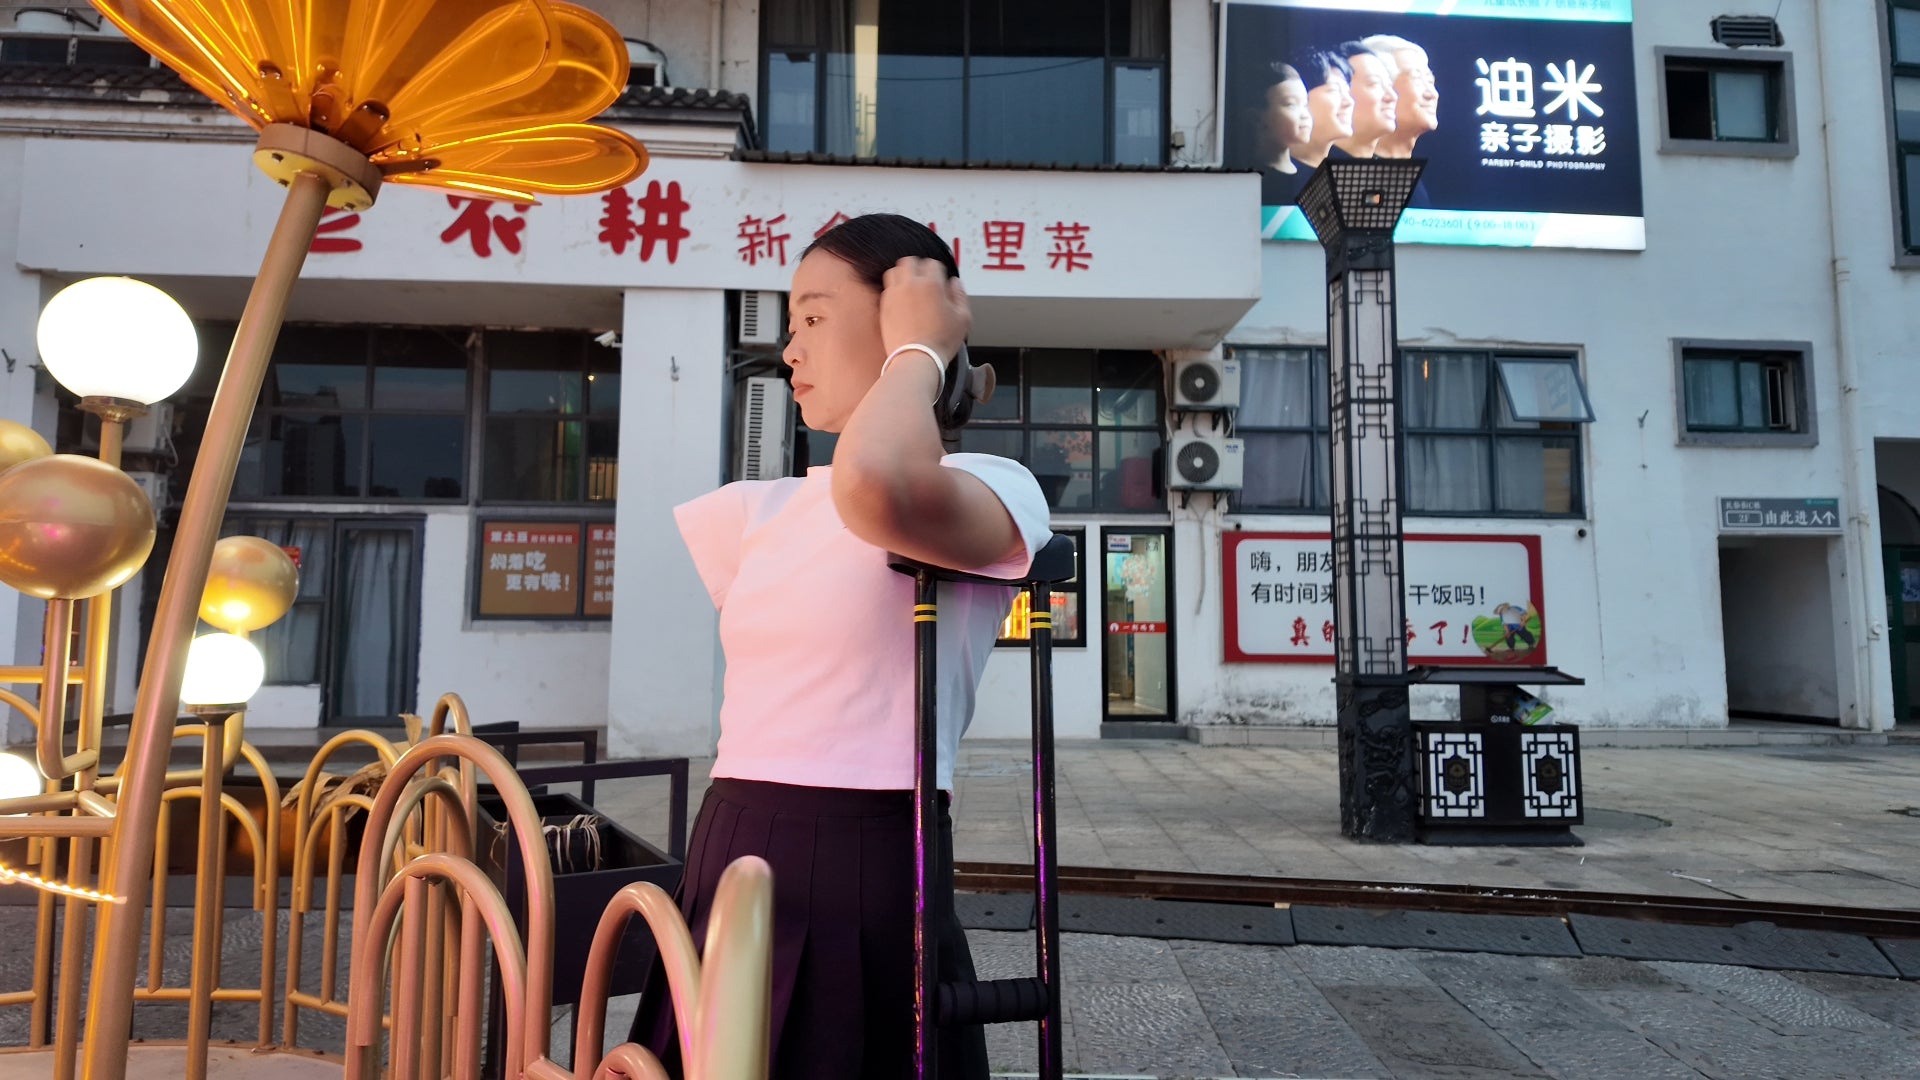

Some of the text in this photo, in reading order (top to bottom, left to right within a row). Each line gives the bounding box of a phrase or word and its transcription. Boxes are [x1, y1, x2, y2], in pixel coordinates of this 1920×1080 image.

[1474, 57, 1604, 121] 迪米
[1480, 121, 1607, 156] 亲子摄影
[1481, 158, 1606, 171] PARENT-CHILD PHOTOGRAPHY
[309, 180, 691, 264] 农耕
[1402, 215, 1462, 228] 90-6223601
[737, 210, 1093, 273] 新里菜
[1765, 509, 1823, 526] 由此进入
